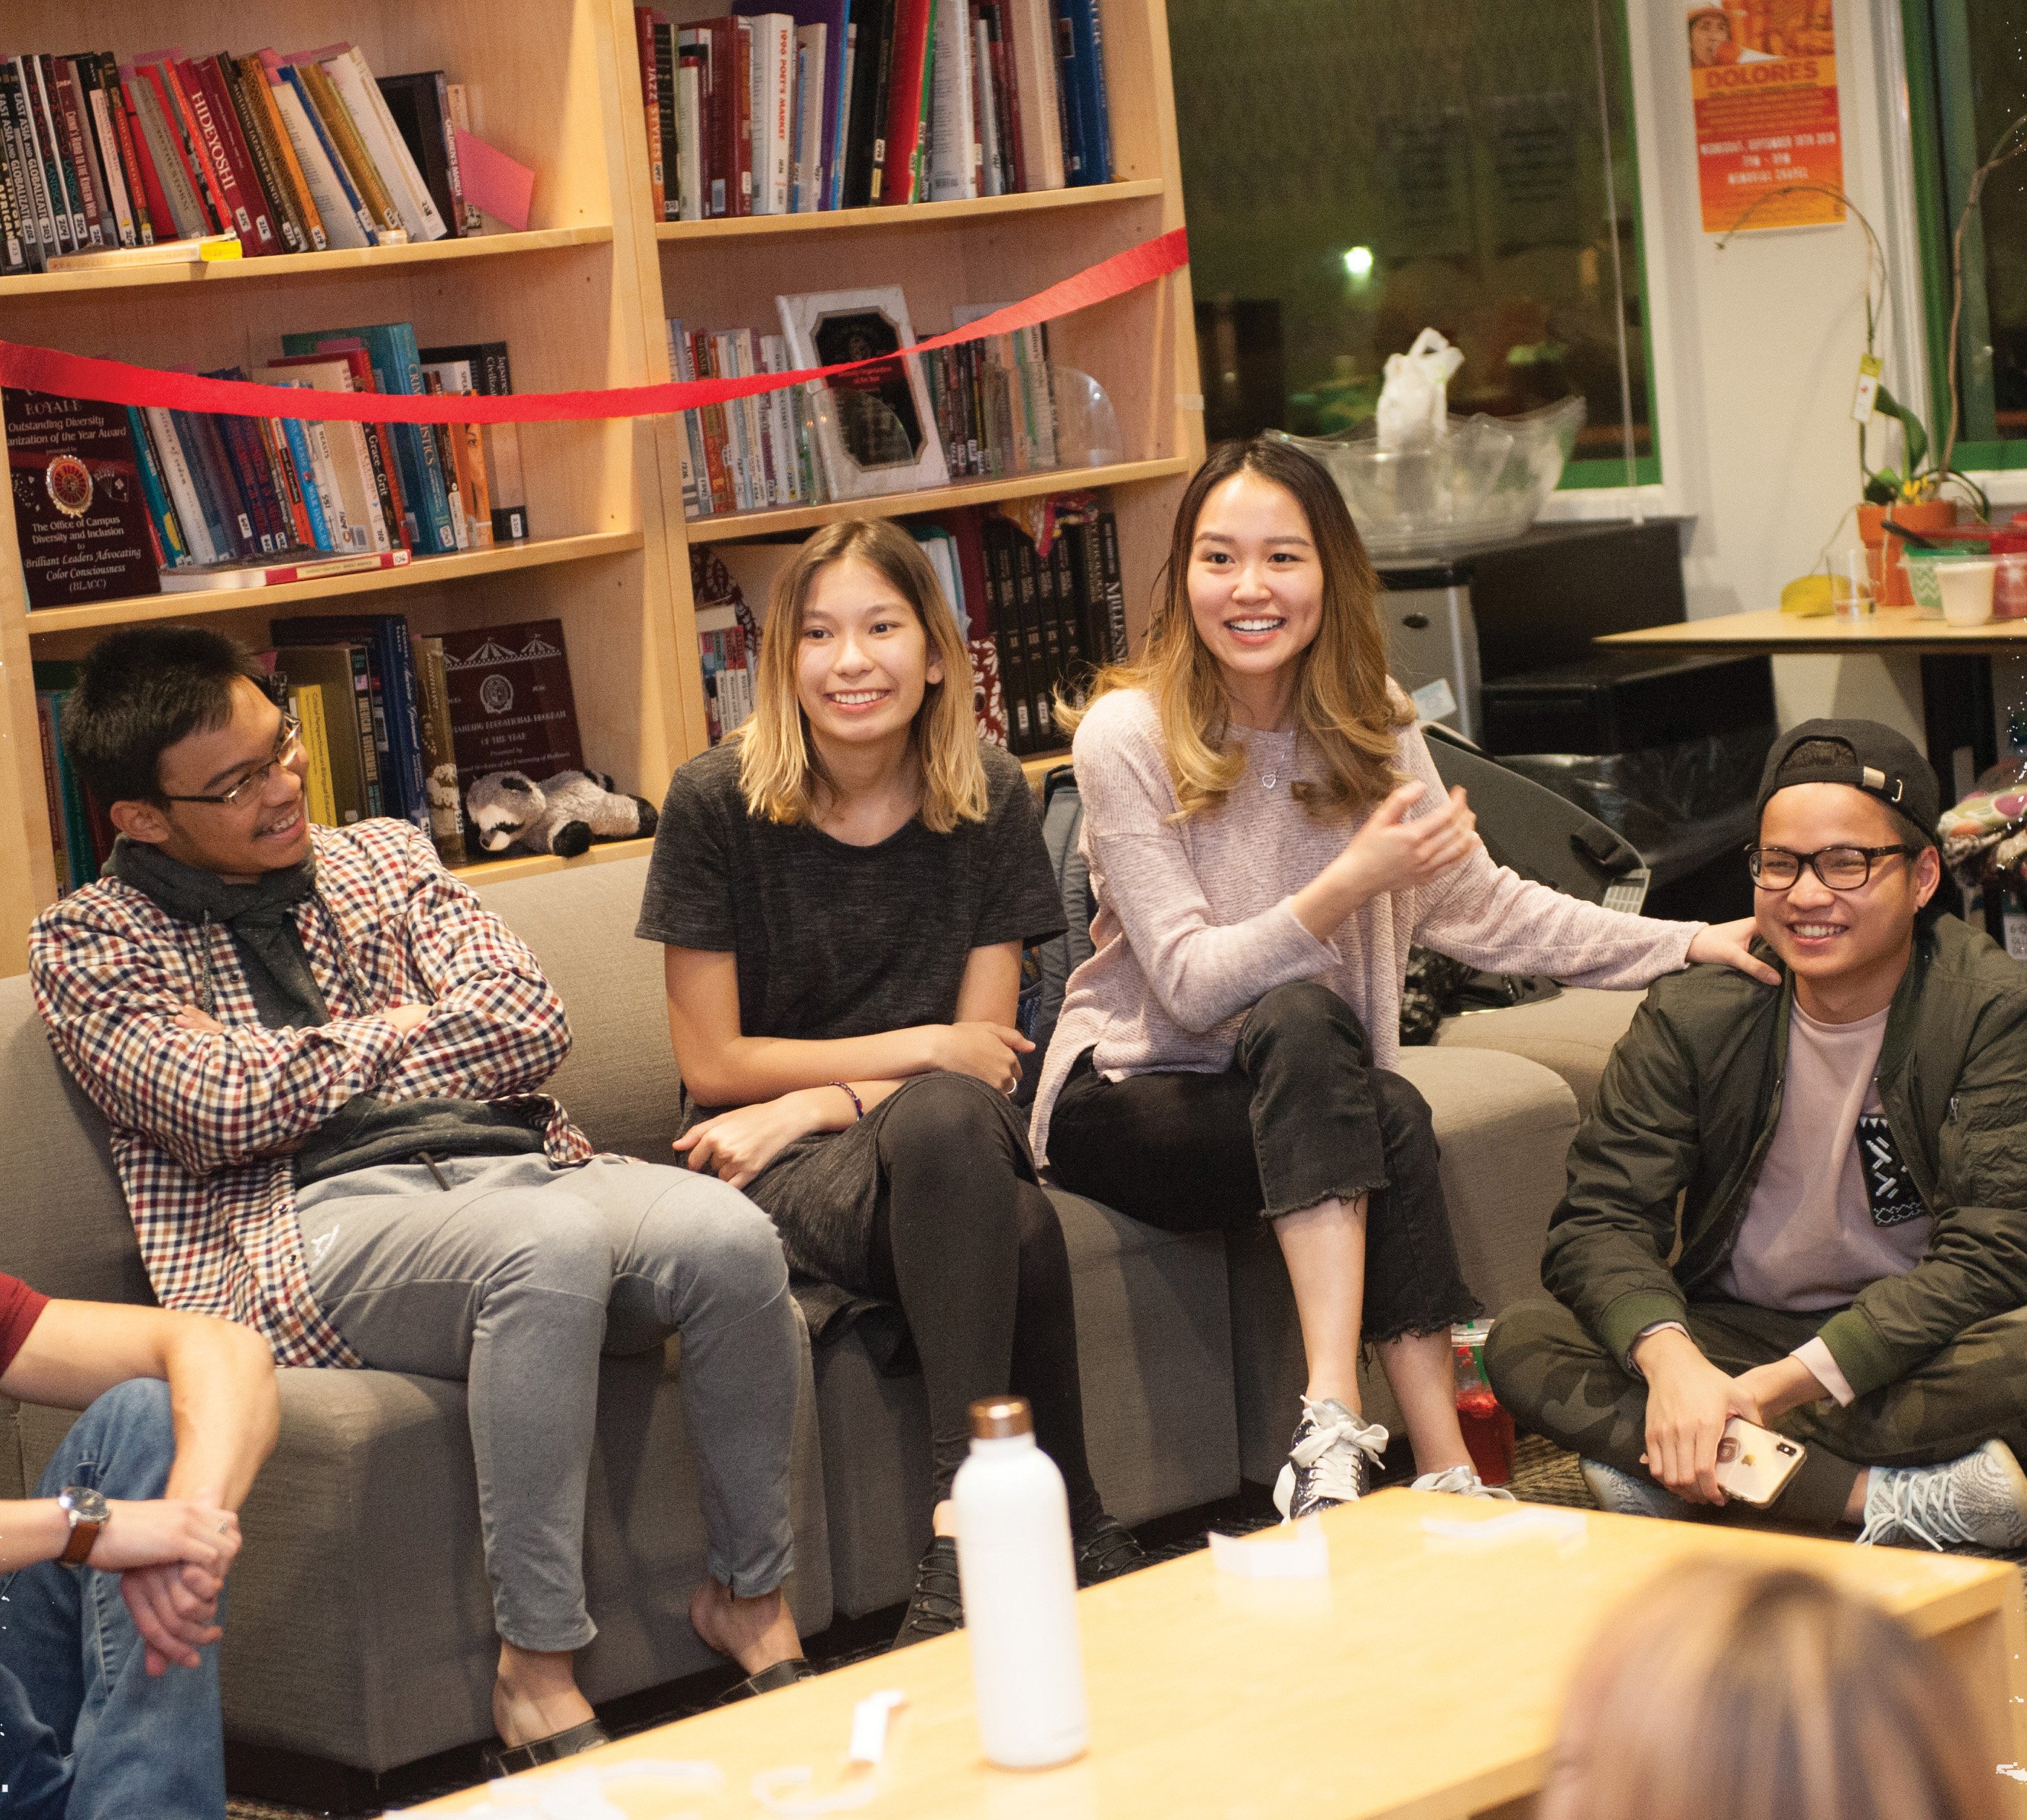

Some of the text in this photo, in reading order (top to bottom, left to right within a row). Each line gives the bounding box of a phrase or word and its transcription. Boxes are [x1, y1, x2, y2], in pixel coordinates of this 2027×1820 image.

[13, 92, 26, 116] EAST
[18, 118, 31, 141] ASIA
[191, 91, 237, 191] HIDEYOSHI
[650, 107, 661, 159] STYLES
[11, 159, 30, 219] GLOBALIZATI
[26, 158, 50, 219] GLOBALIZATI
[487, 356, 497, 396] Civiliza
[497, 355, 509, 395] Japanes
[8, 428, 126, 447] anization of the Year Award
[9, 415, 104, 432] Outstanding Diversity
[369, 435, 388, 497] Grace Grit
[33, 523, 48, 532] The
[50, 520, 73, 531] Office
[86, 516, 120, 528] Campus
[33, 533, 67, 544] Diversity
[87, 527, 124, 538] Inclusion
[25, 548, 141, 569] Brilliant Leaders Advocating
[46, 564, 125, 581] Color Consciousness
[1106, 582, 1127, 664] MILLENNI
